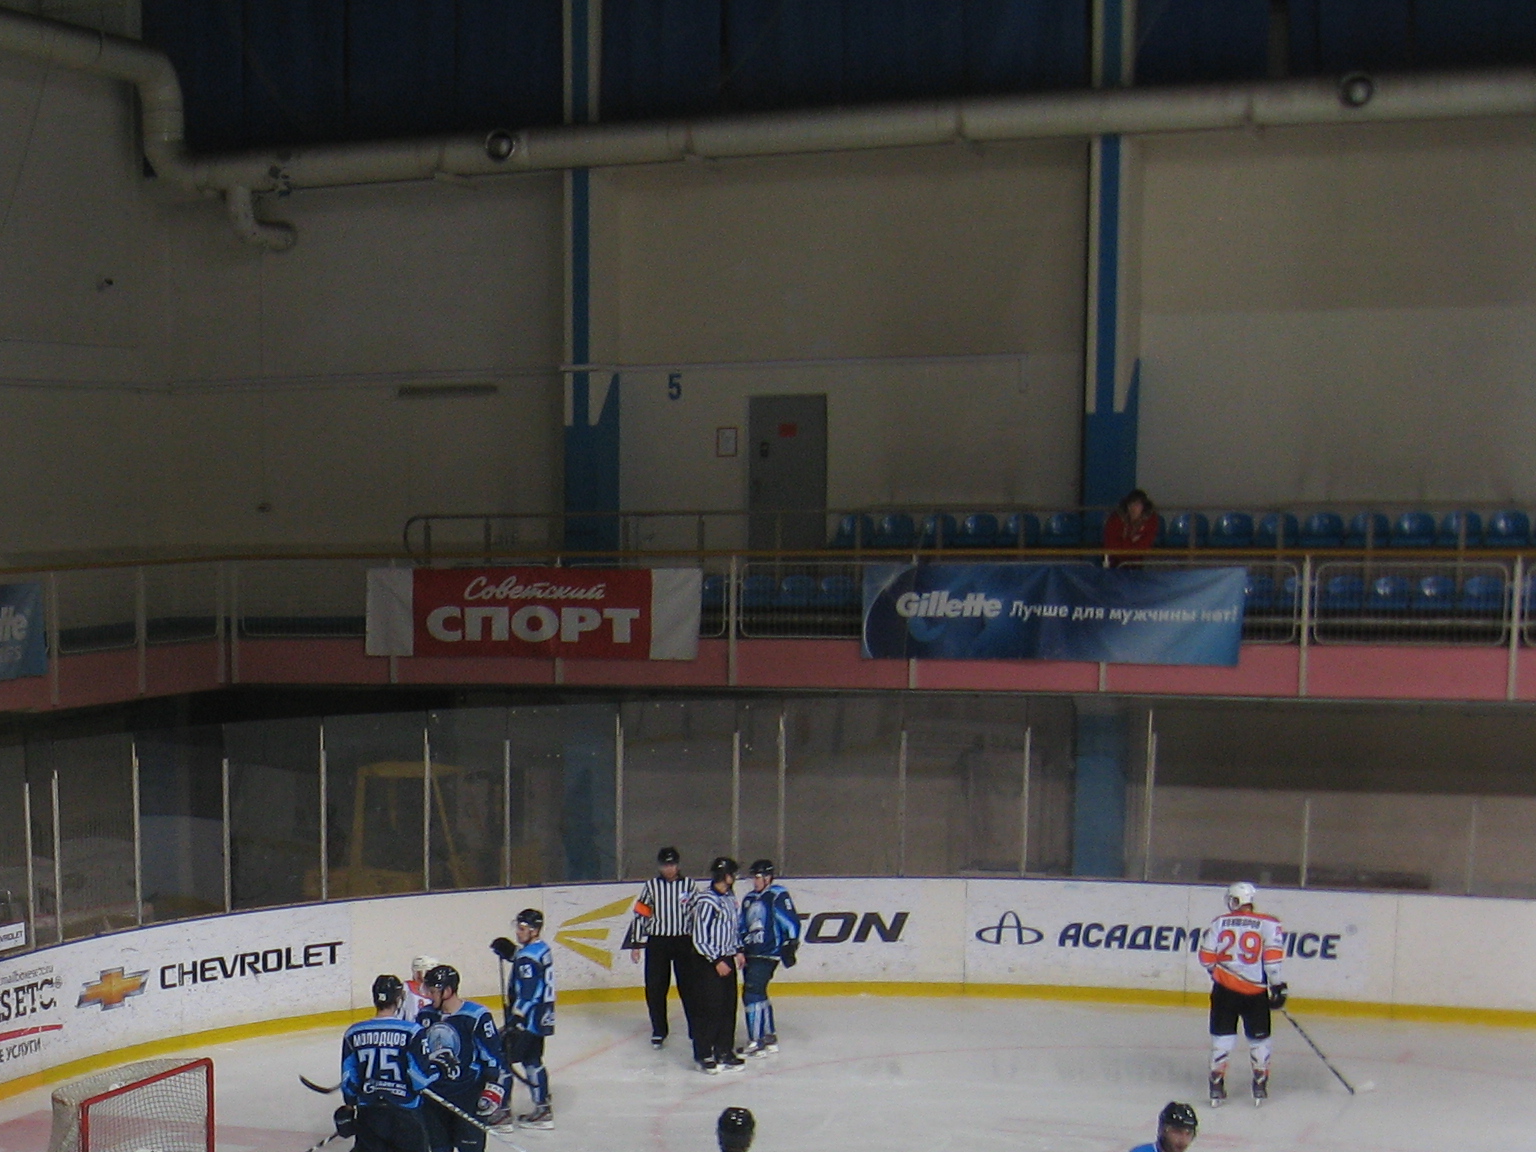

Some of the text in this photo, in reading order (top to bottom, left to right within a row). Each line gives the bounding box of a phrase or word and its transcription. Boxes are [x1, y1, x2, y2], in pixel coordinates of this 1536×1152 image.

[668, 373, 682, 399] 5
[464, 576, 605, 601] Советский
[426, 605, 640, 643] СПОРТ
[896, 591, 1002, 618] Gillette
[1009, 600, 1068, 622] Лучше
[1072, 605, 1104, 623] для
[1109, 608, 1196, 625] мужчины
[1217, 929, 1262, 964] 29
[160, 941, 344, 990] CHEVROLET
[6, 1038, 42, 1062] УСЛУГИ
[353, 1031, 407, 1047] МОЛОДЦОВ
[357, 1047, 402, 1081] 75
